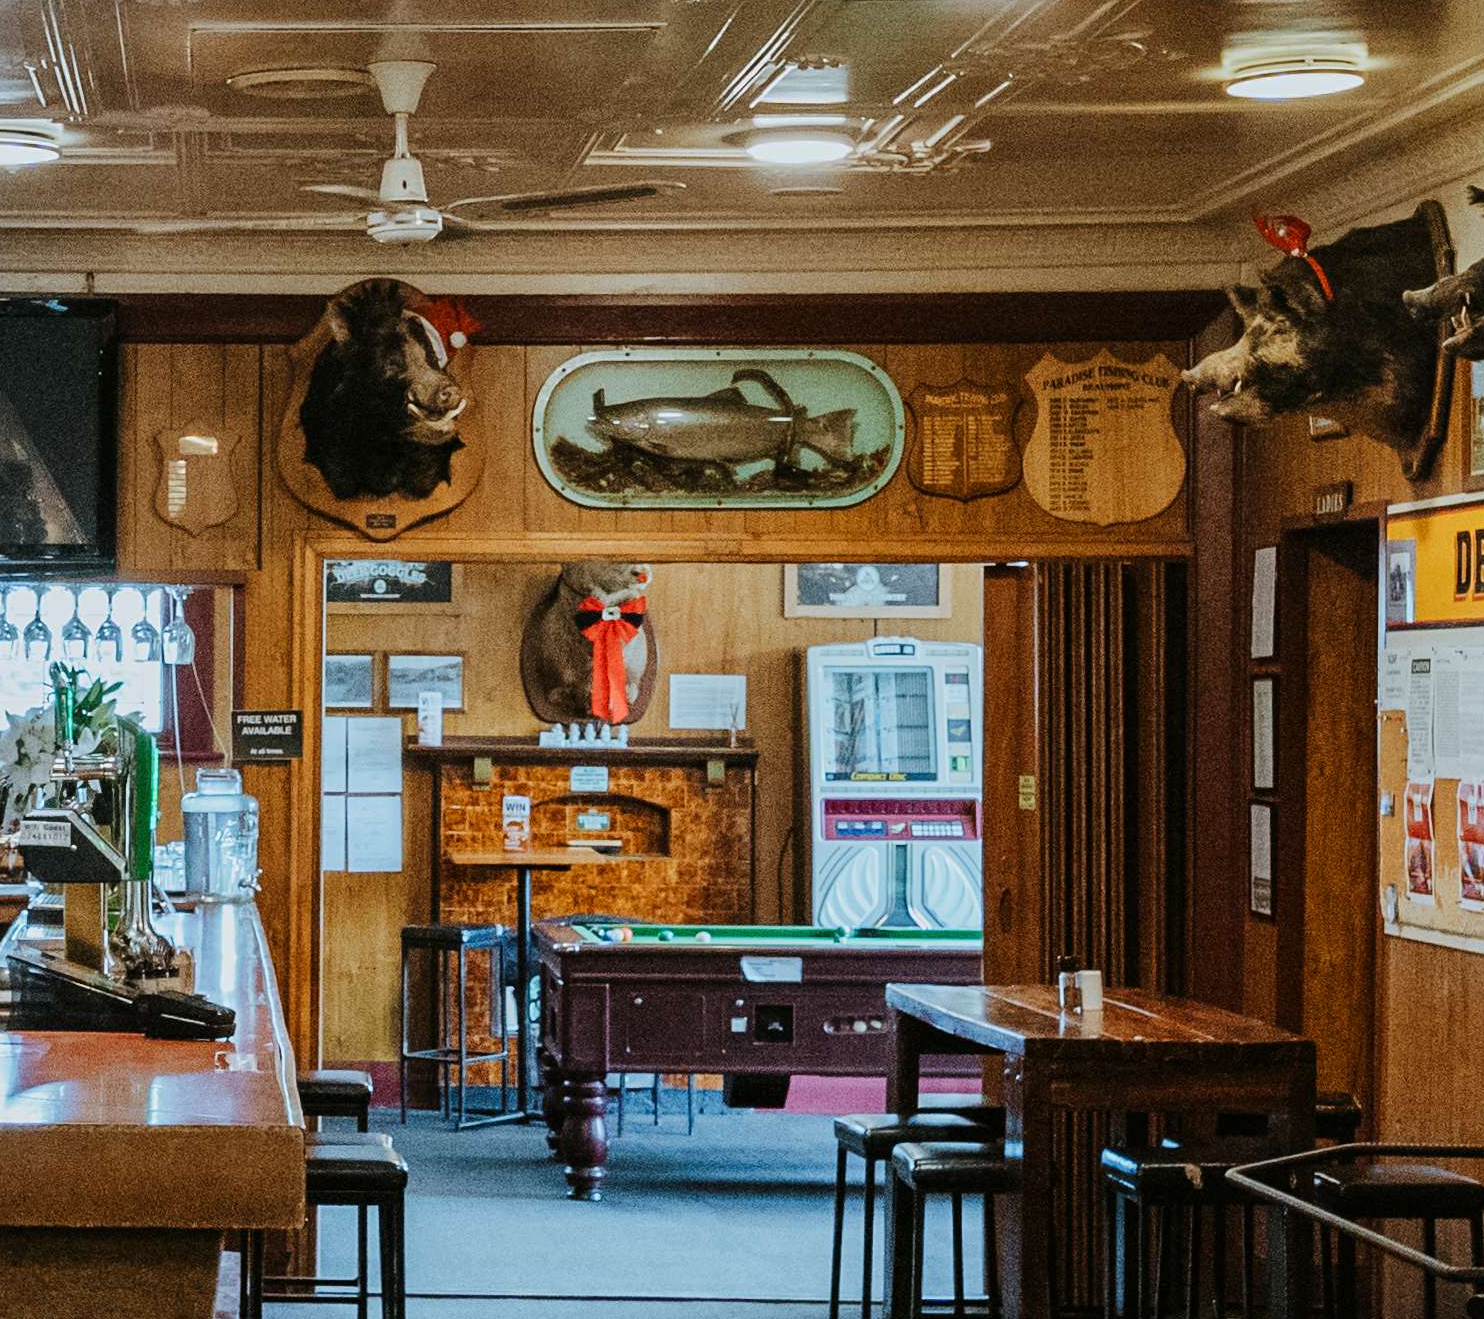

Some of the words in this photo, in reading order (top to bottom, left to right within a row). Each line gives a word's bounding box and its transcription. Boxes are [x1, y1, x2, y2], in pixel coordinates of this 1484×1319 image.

[1042, 368, 1094, 390] PARADISE
[237, 715, 262, 724] FREE
[263, 714, 297, 724] WATER
[241, 725, 292, 735] AVAILABLE
[505, 802, 526, 812] WIN
